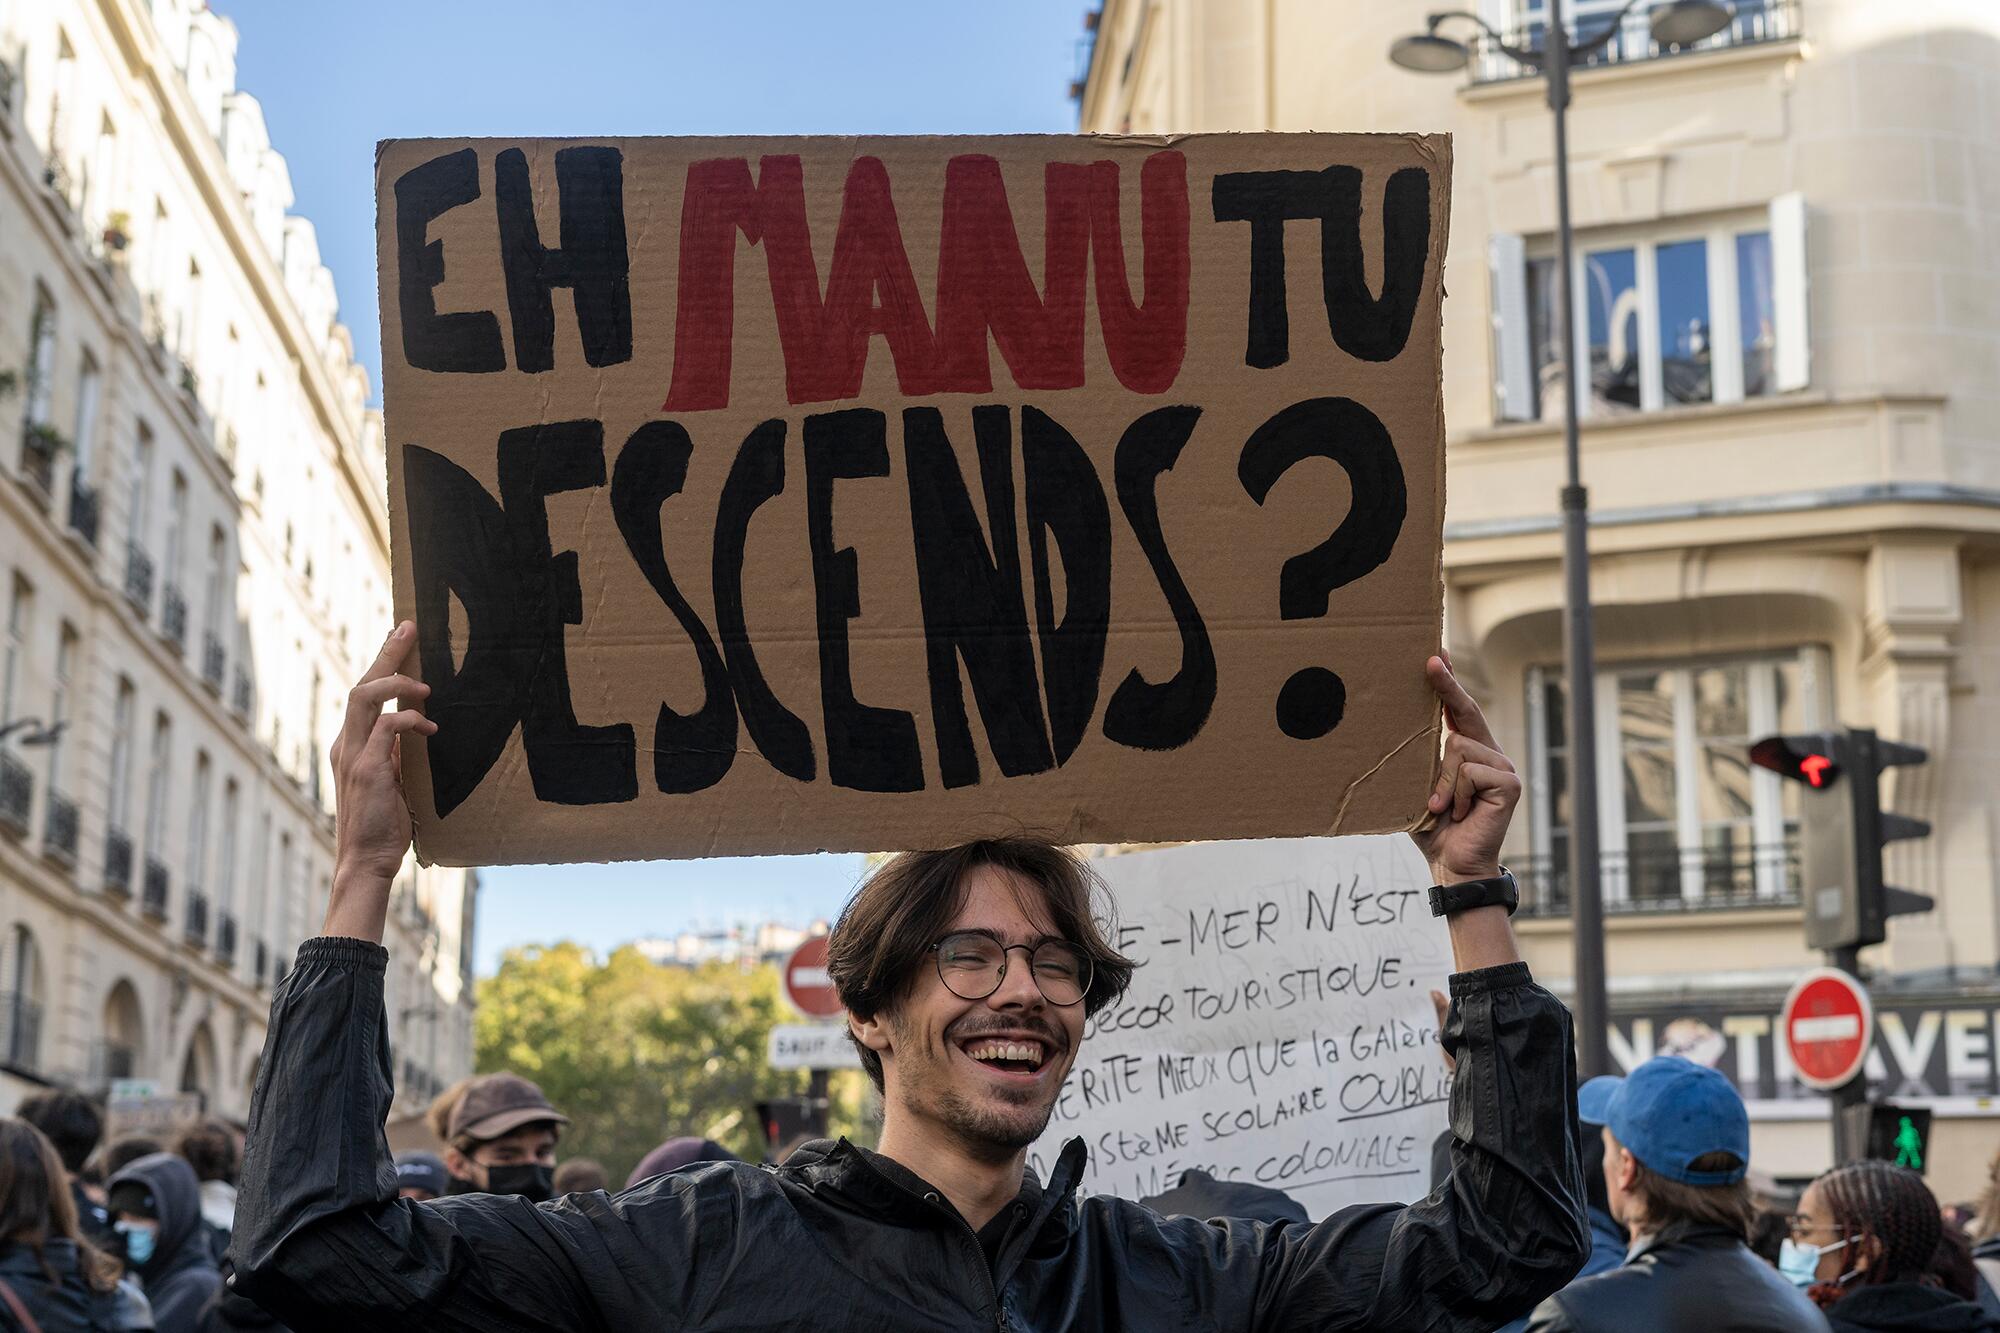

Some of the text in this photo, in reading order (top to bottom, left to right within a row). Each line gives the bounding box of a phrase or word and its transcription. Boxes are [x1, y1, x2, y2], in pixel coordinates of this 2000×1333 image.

[394, 146, 1431, 412] EH MANU TU
[1312, 1029, 1341, 1067] la
